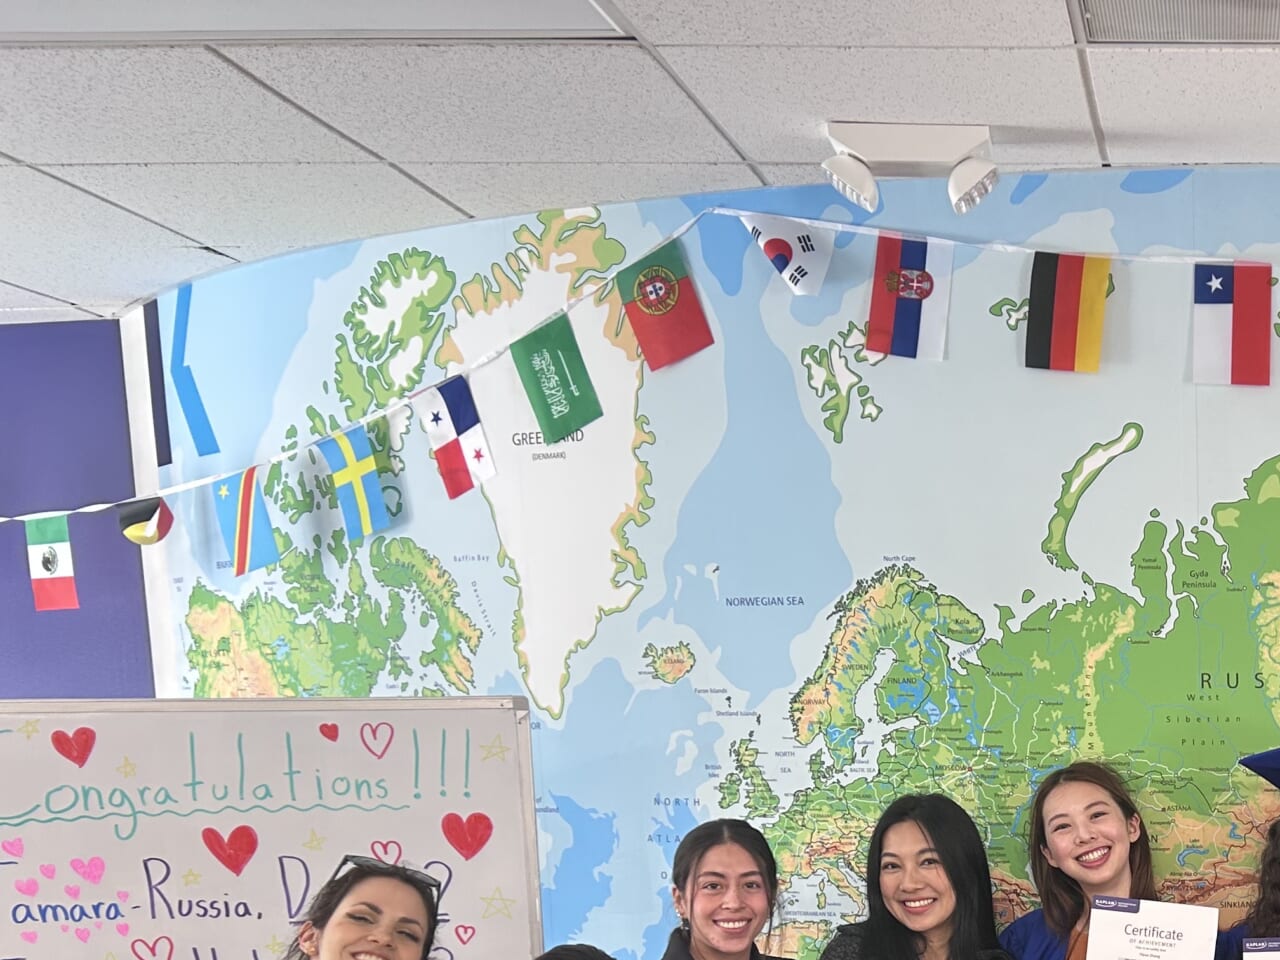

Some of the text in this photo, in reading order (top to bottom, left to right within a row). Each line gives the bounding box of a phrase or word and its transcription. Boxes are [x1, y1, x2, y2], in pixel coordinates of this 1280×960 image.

[512, 428, 584, 446] GREEAND
[477, 554, 490, 562] Bay
[901, 555, 916, 563] Cape
[1189, 570, 1209, 579] Gyda
[1182, 581, 1217, 589] Peninsula
[725, 596, 805, 607] NORWEGIAN SEA
[1166, 715, 1241, 723] Siberian
[1181, 738, 1226, 746] Plain
[654, 797, 701, 806] NORTH
[1124, 923, 1184, 941] Certificate
